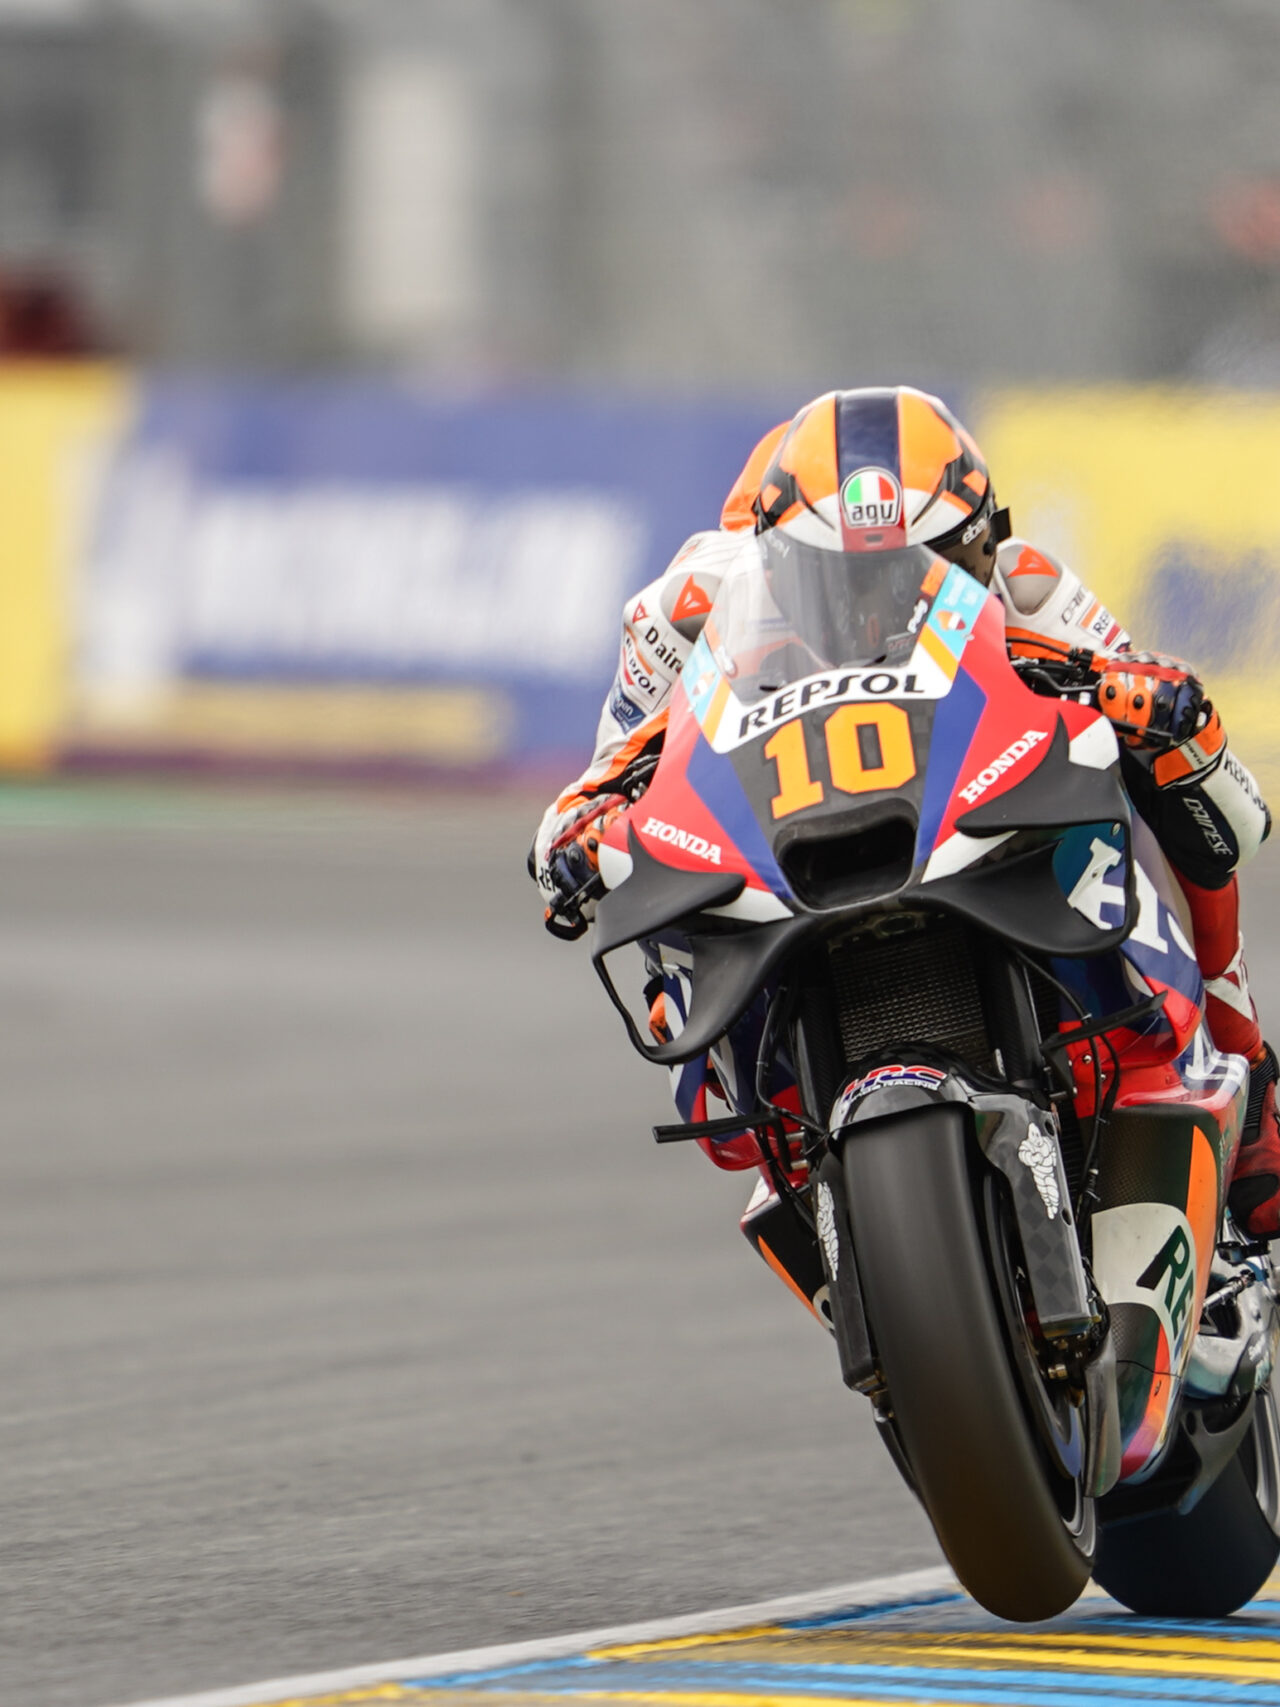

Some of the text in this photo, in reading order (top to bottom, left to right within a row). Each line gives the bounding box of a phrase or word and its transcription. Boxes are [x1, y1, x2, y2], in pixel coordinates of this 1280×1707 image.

[852, 503, 894, 525] agv
[738, 673, 926, 739] REPSOL
[763, 702, 918, 820] 10
[958, 729, 1049, 805] HONDA
[640, 816, 722, 866] HONDA
[1182, 796, 1234, 856] DAINESE
